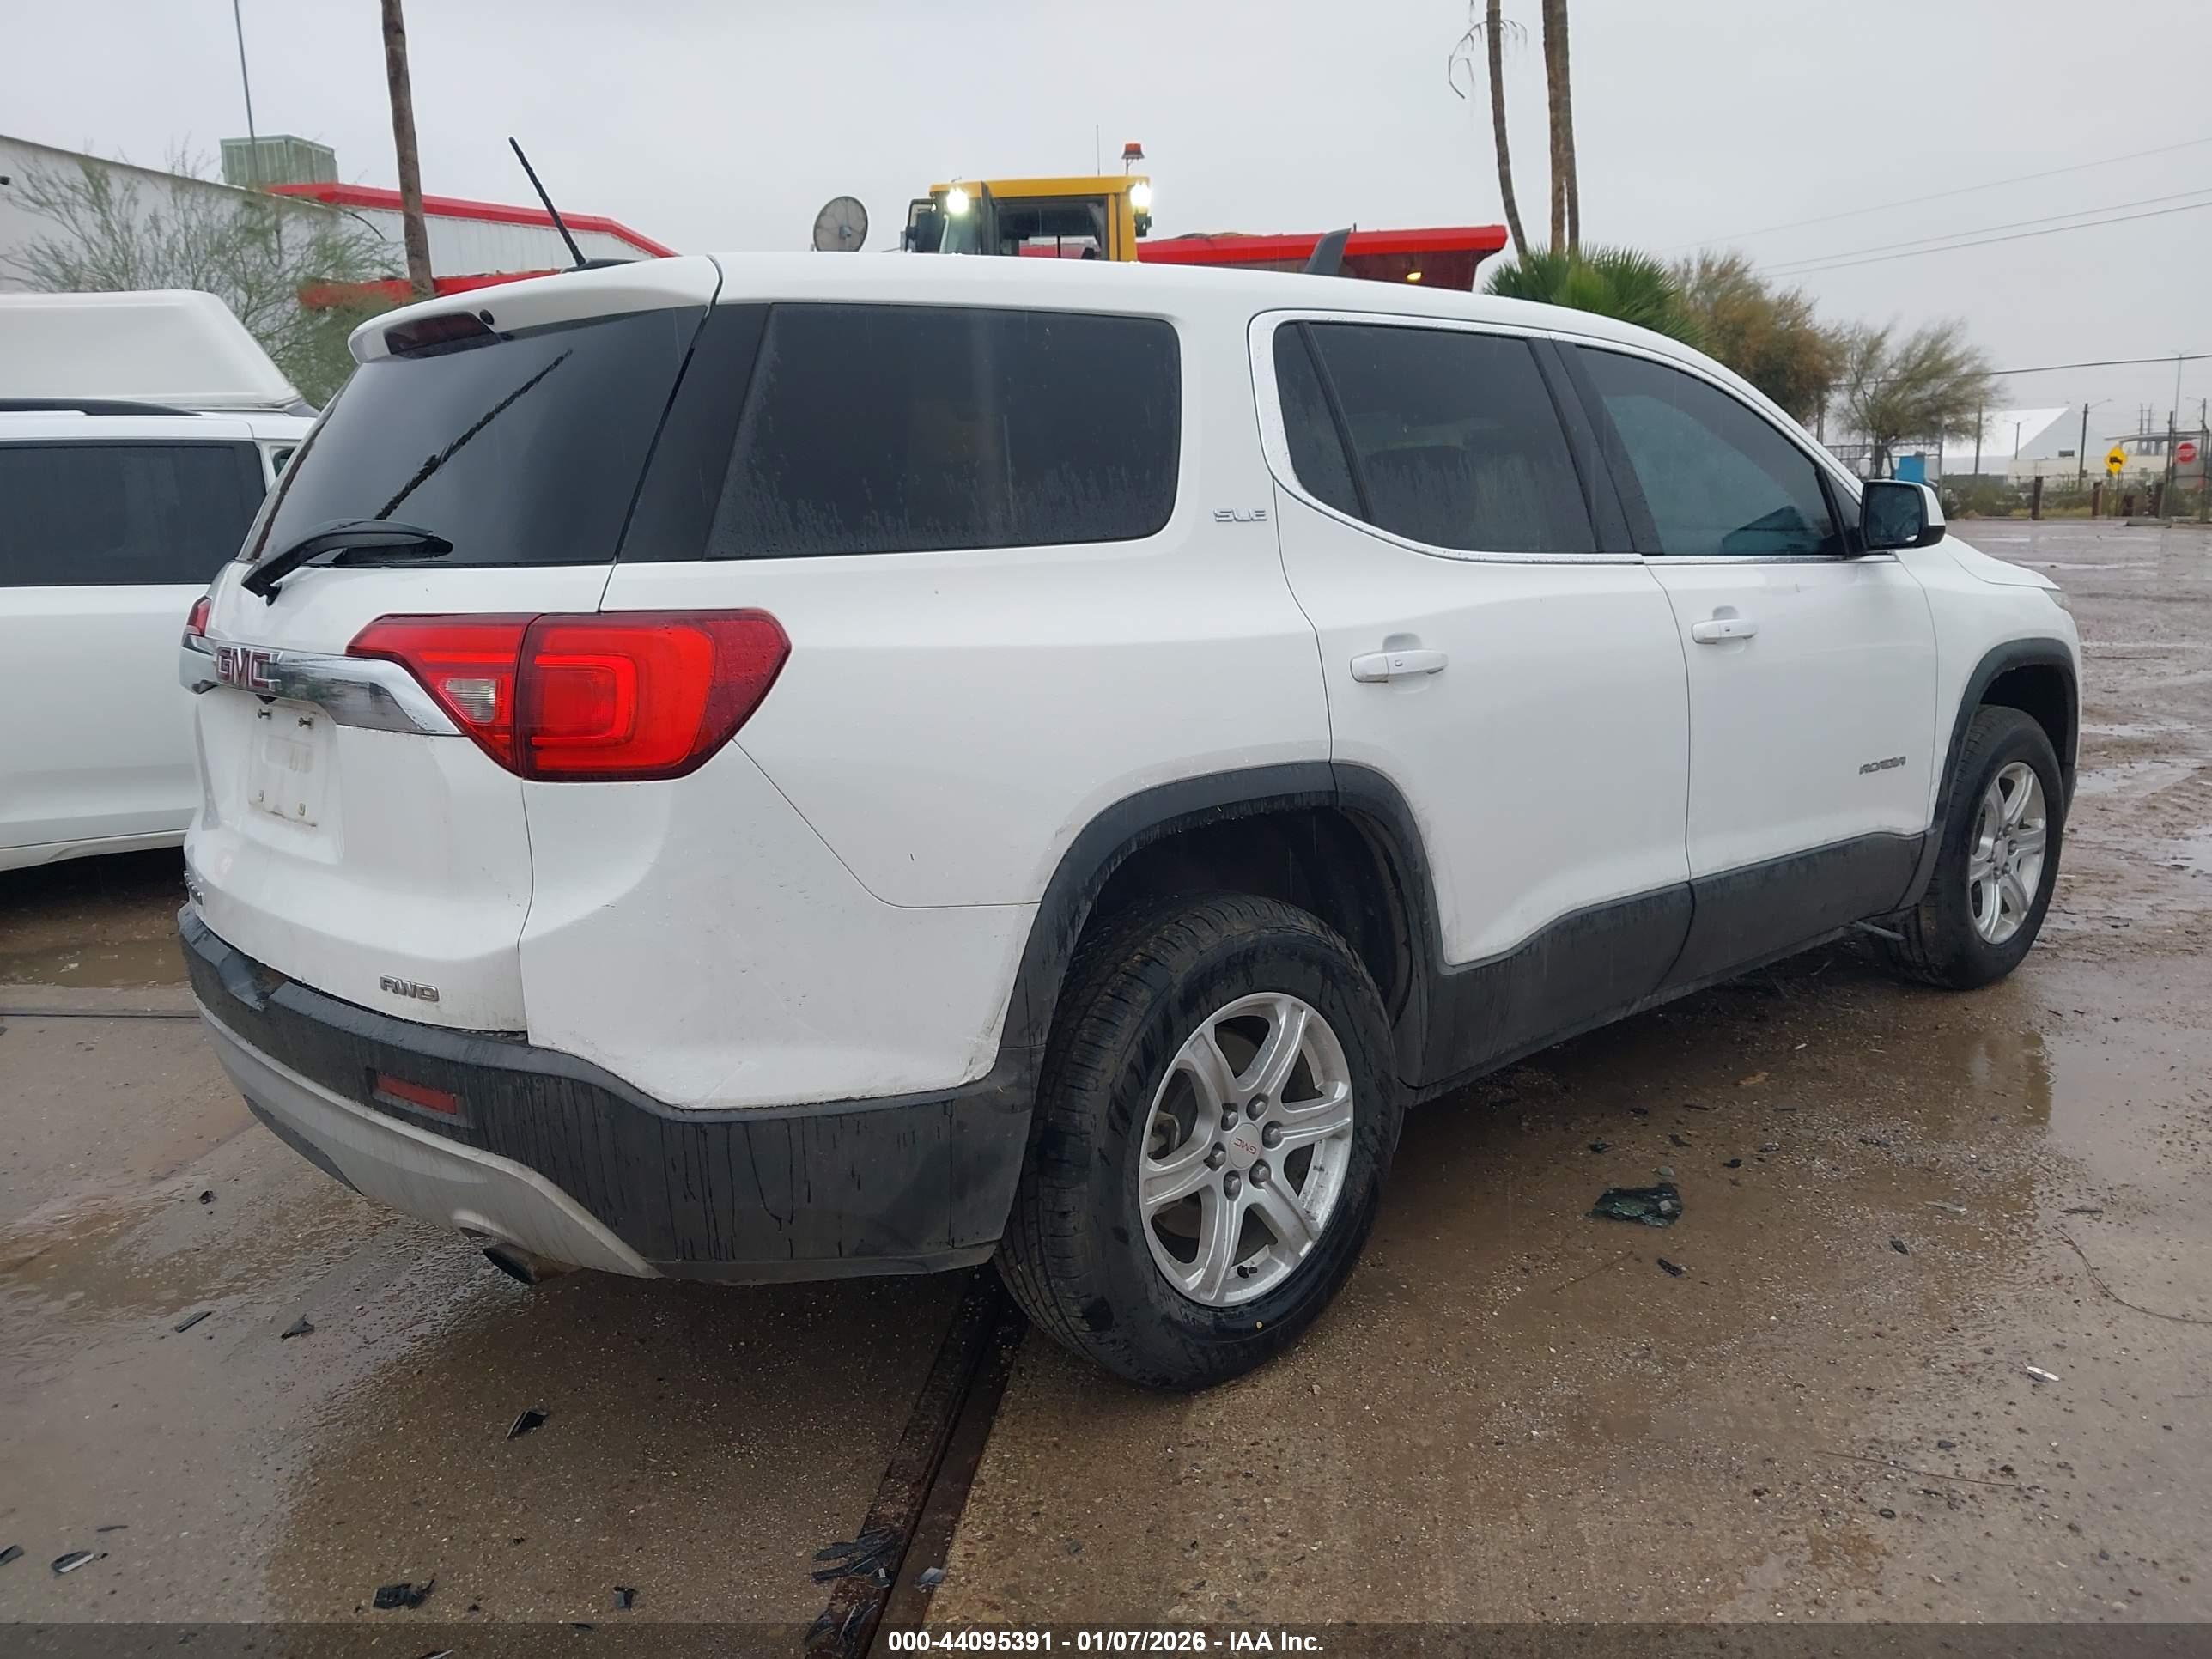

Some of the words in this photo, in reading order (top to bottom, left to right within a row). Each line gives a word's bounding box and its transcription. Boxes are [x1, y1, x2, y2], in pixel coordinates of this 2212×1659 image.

[1213, 508, 1267, 523] SLE
[216, 645, 281, 691] GMC
[1233, 1137, 1257, 1155] GMC
